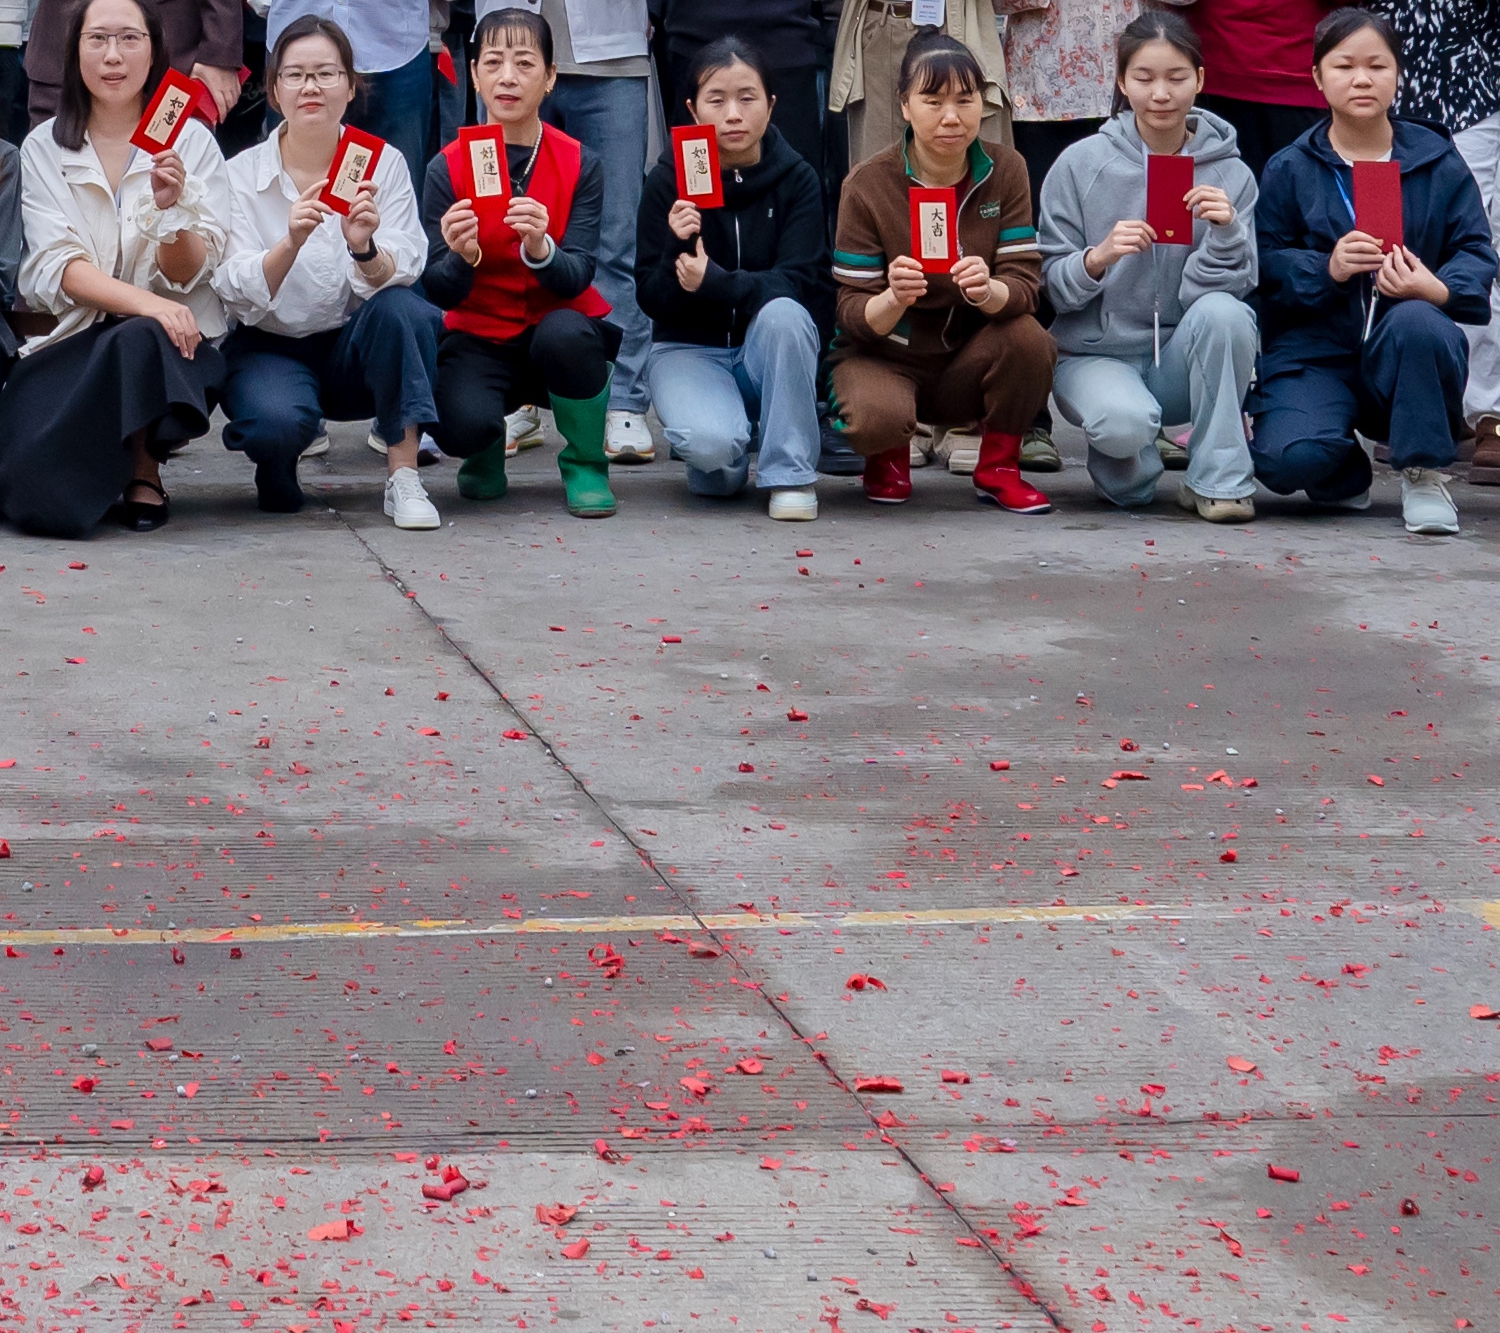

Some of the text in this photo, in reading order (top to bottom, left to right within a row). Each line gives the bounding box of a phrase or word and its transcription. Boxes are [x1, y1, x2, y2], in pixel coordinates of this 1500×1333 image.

[166, 96, 184, 126] 如意
[480, 145, 498, 176] 好運
[692, 145, 708, 175] 如意
[931, 208, 945, 237] 大吉
